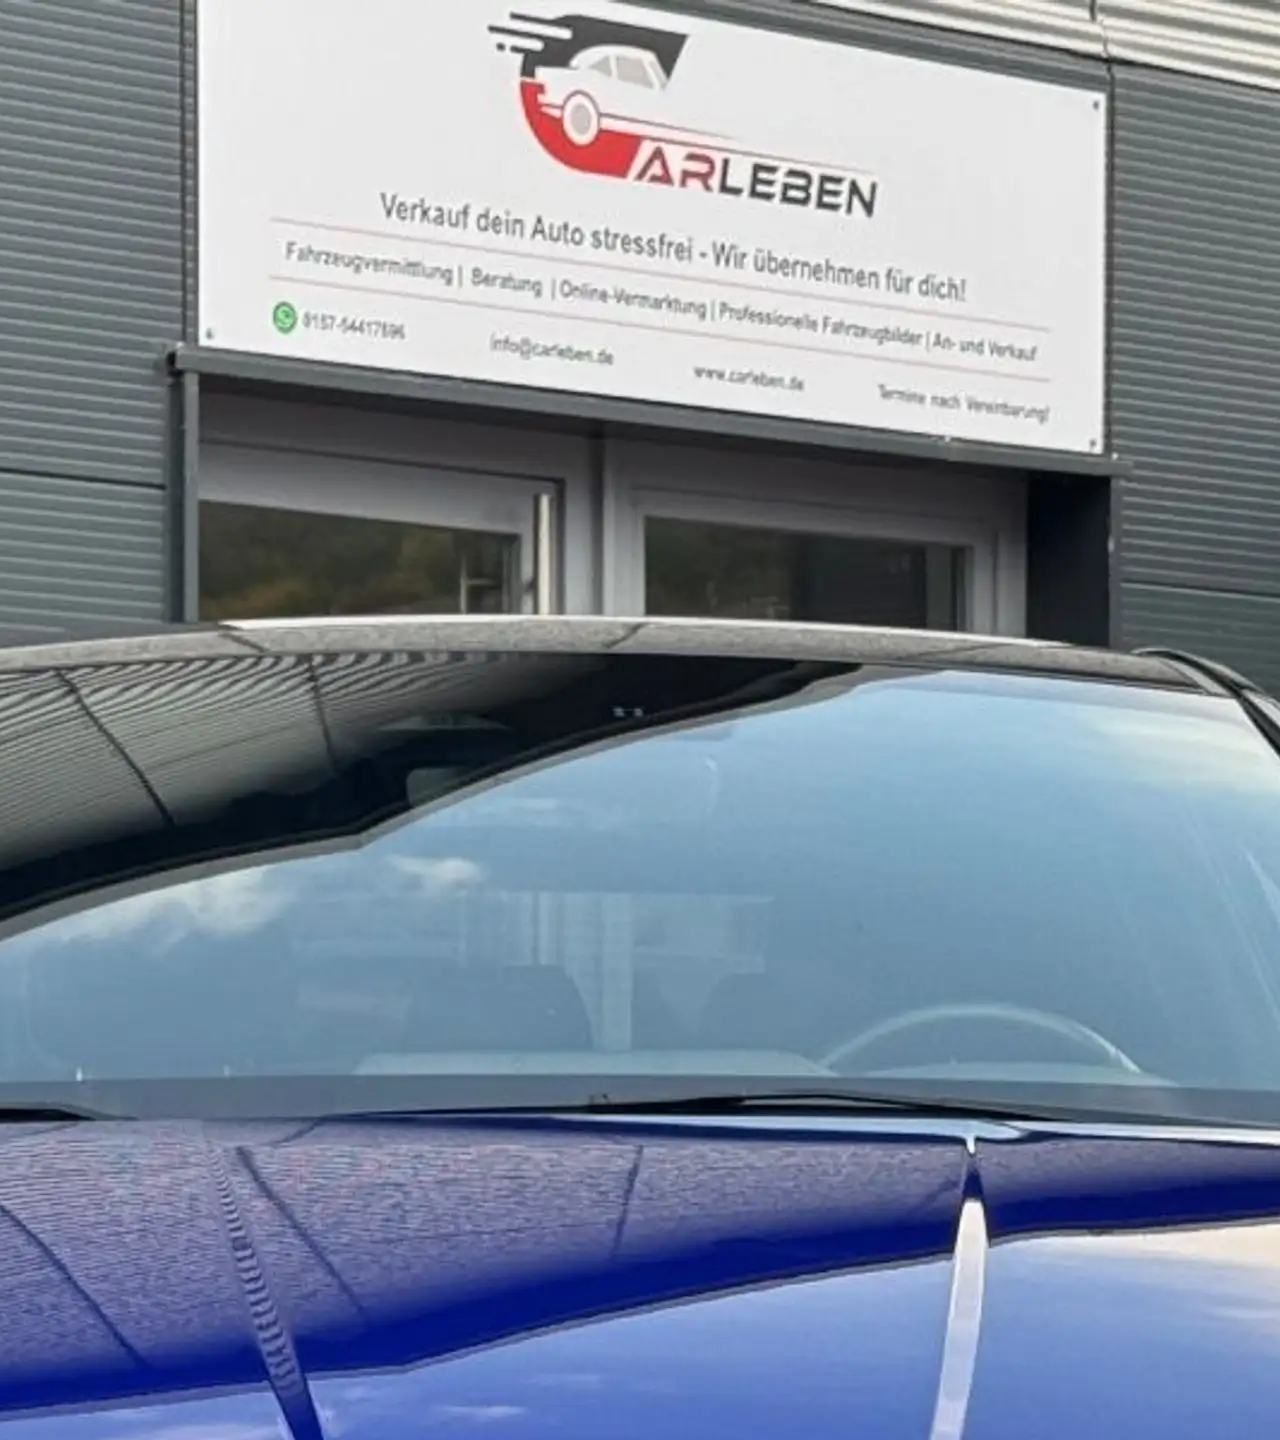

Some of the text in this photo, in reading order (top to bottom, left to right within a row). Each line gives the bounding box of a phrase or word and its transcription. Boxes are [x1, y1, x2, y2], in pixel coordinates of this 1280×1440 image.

[285, 241, 453, 287] Fahrzeugvermittlung
[471, 267, 543, 298] Beratung
[719, 300, 818, 334] Professionelle
[959, 338, 985, 356] und
[988, 340, 1038, 362] Verkauf
[380, 192, 471, 230] Verkauf
[476, 208, 525, 239] dein
[531, 215, 584, 246] Auto
[591, 226, 694, 262] stressfrei
[712, 239, 748, 270] Wir
[753, 249, 880, 291] übernehmen
[885, 267, 913, 294] für
[918, 273, 967, 302] dich!
